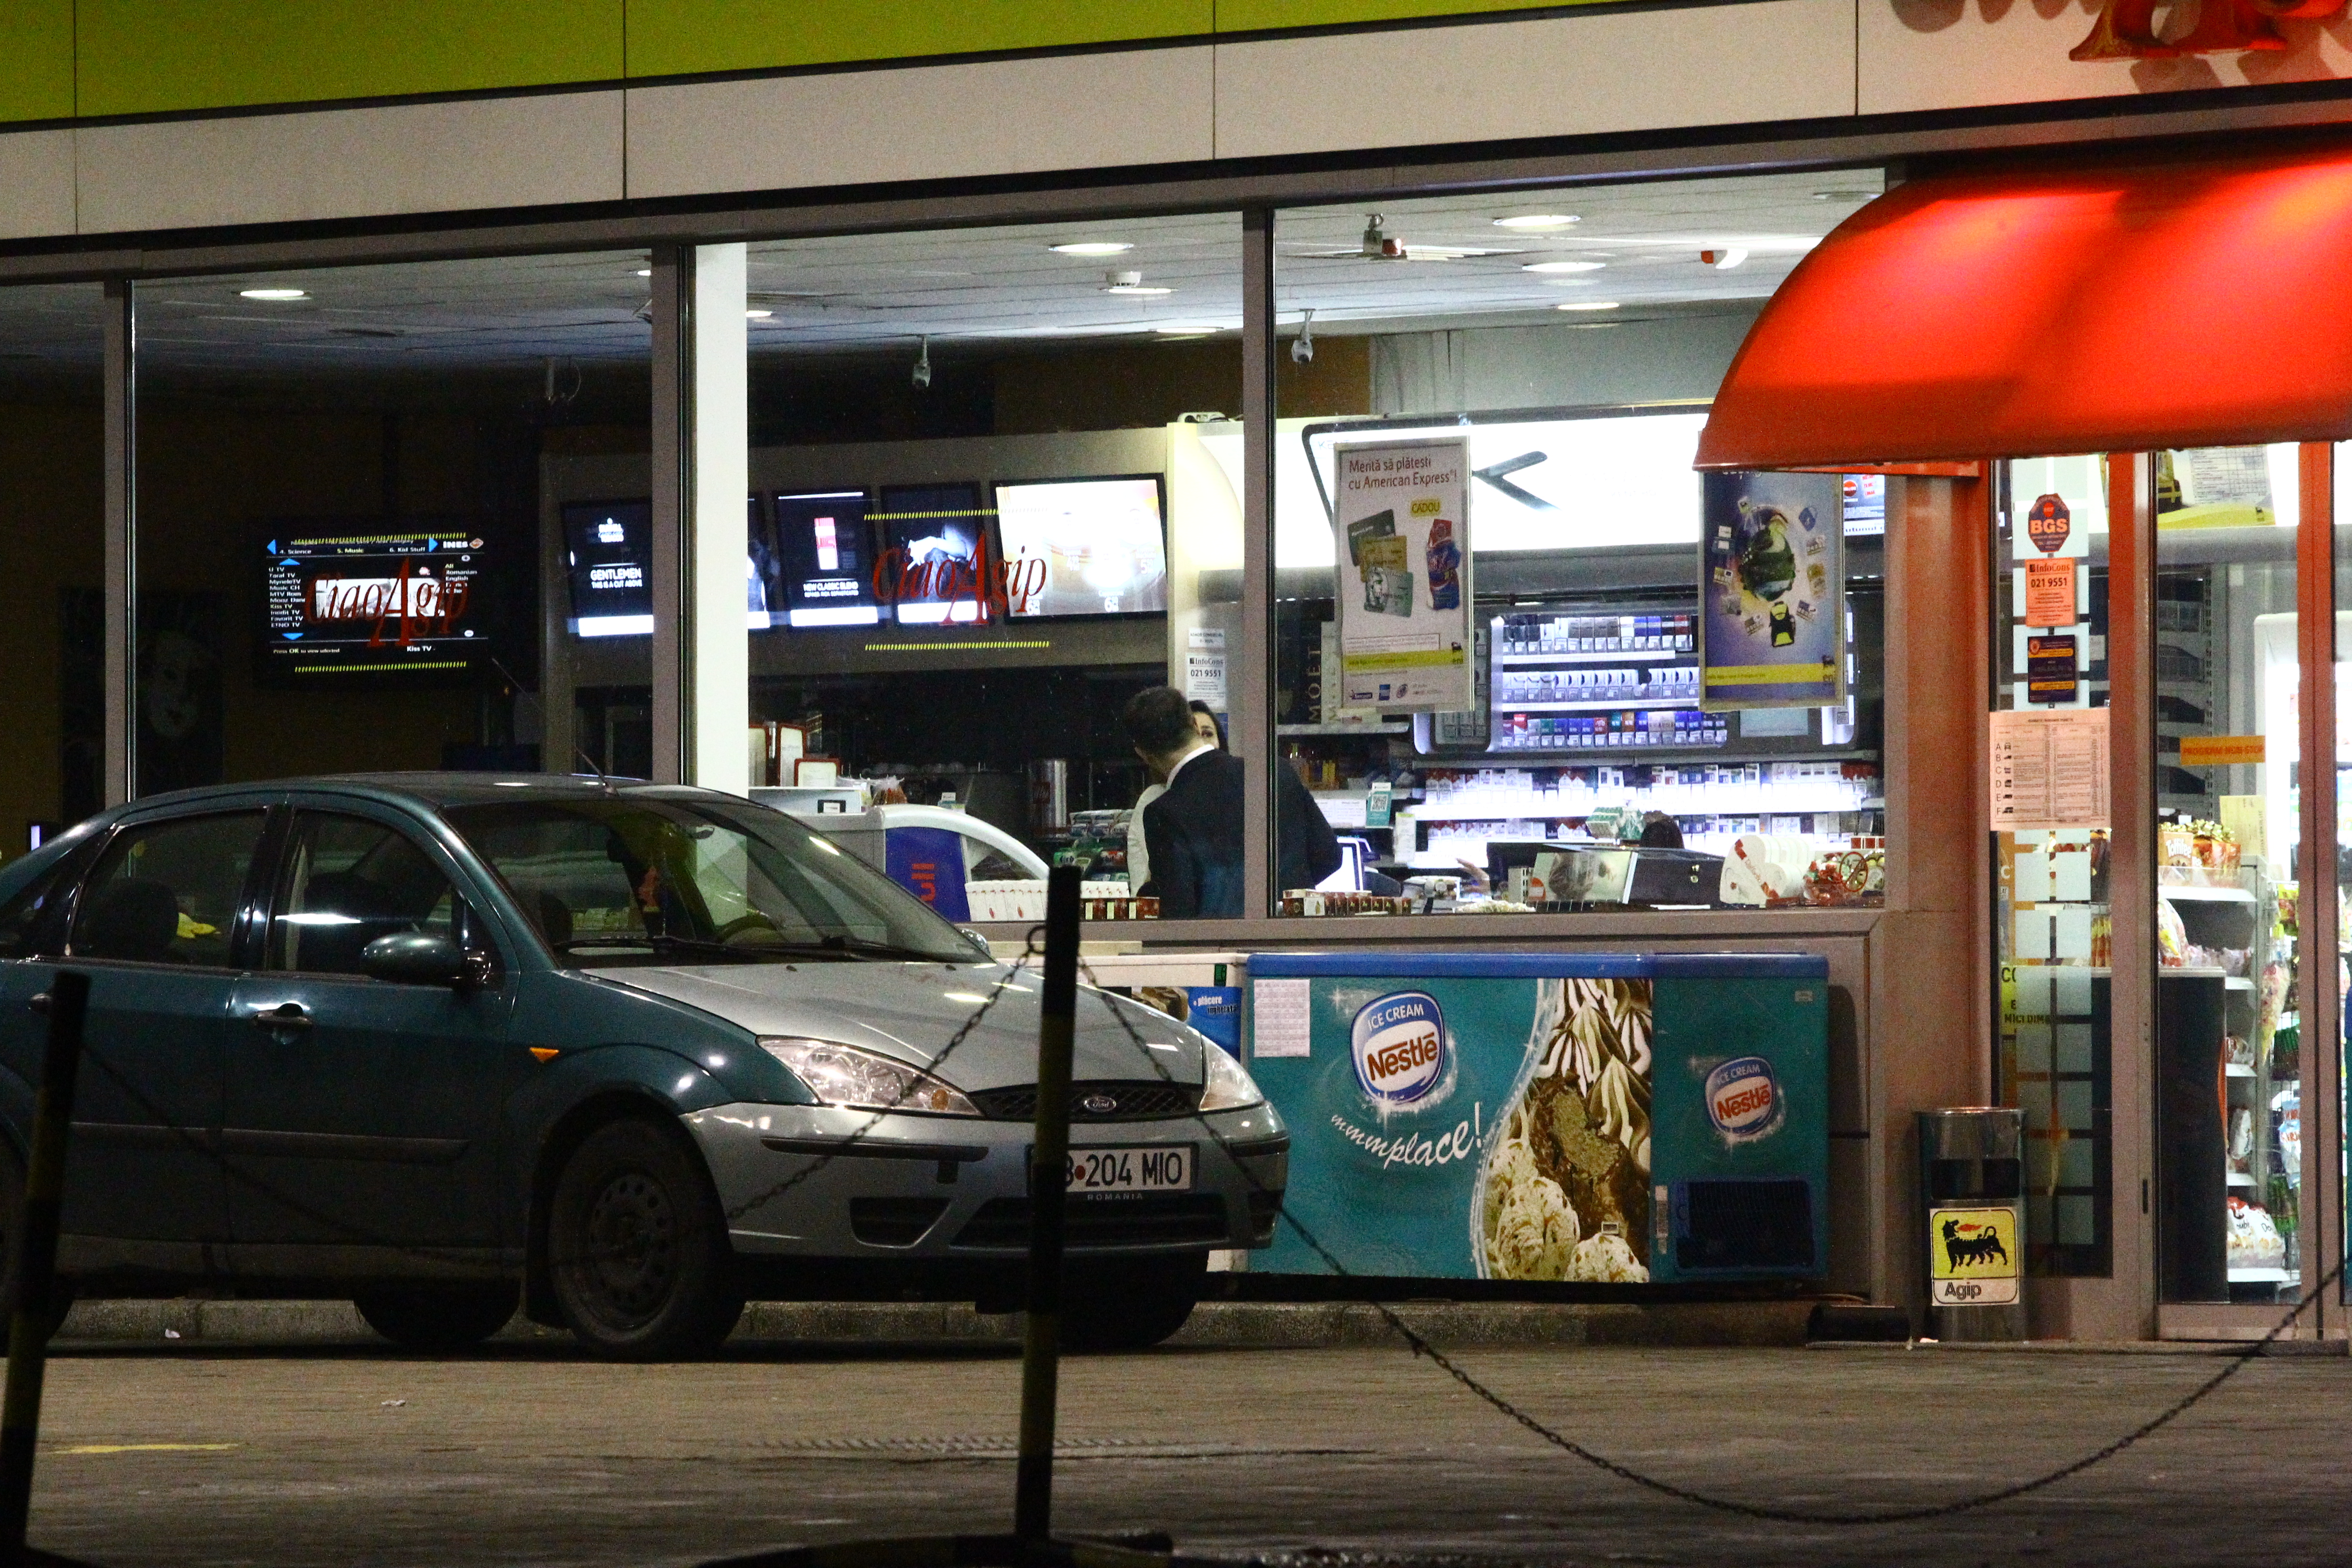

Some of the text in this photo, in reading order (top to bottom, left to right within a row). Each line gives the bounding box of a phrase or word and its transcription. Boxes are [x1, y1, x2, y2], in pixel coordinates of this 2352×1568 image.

[1384, 459, 1393, 470] să
[1348, 480, 1360, 490] cu
[1363, 476, 1410, 489] American
[1412, 501, 1440, 513] CADOU
[2030, 518, 2068, 534] BGS
[590, 567, 642, 581] GENTLEMEN
[2036, 563, 2070, 573] InfoCons
[591, 581, 603, 589] THIS
[613, 580, 624, 588] CUT
[625, 579, 643, 588] ABOVE
[803, 581, 859, 591] NEW CLASSIC BLEND
[2031, 577, 2068, 588] 021 9551
[1190, 669, 1221, 677] 021 9551
[911, 863, 936, 902] ull
[1368, 1004, 1424, 1032] ICE CREAM
[1730, 1064, 1761, 1078] CREAM
[1085, 1153, 1132, 1187] 204
[1142, 1152, 1182, 1186] MIO
[1088, 1192, 1143, 1200] ROMANIA
[1945, 1281, 1982, 1300] Agip
